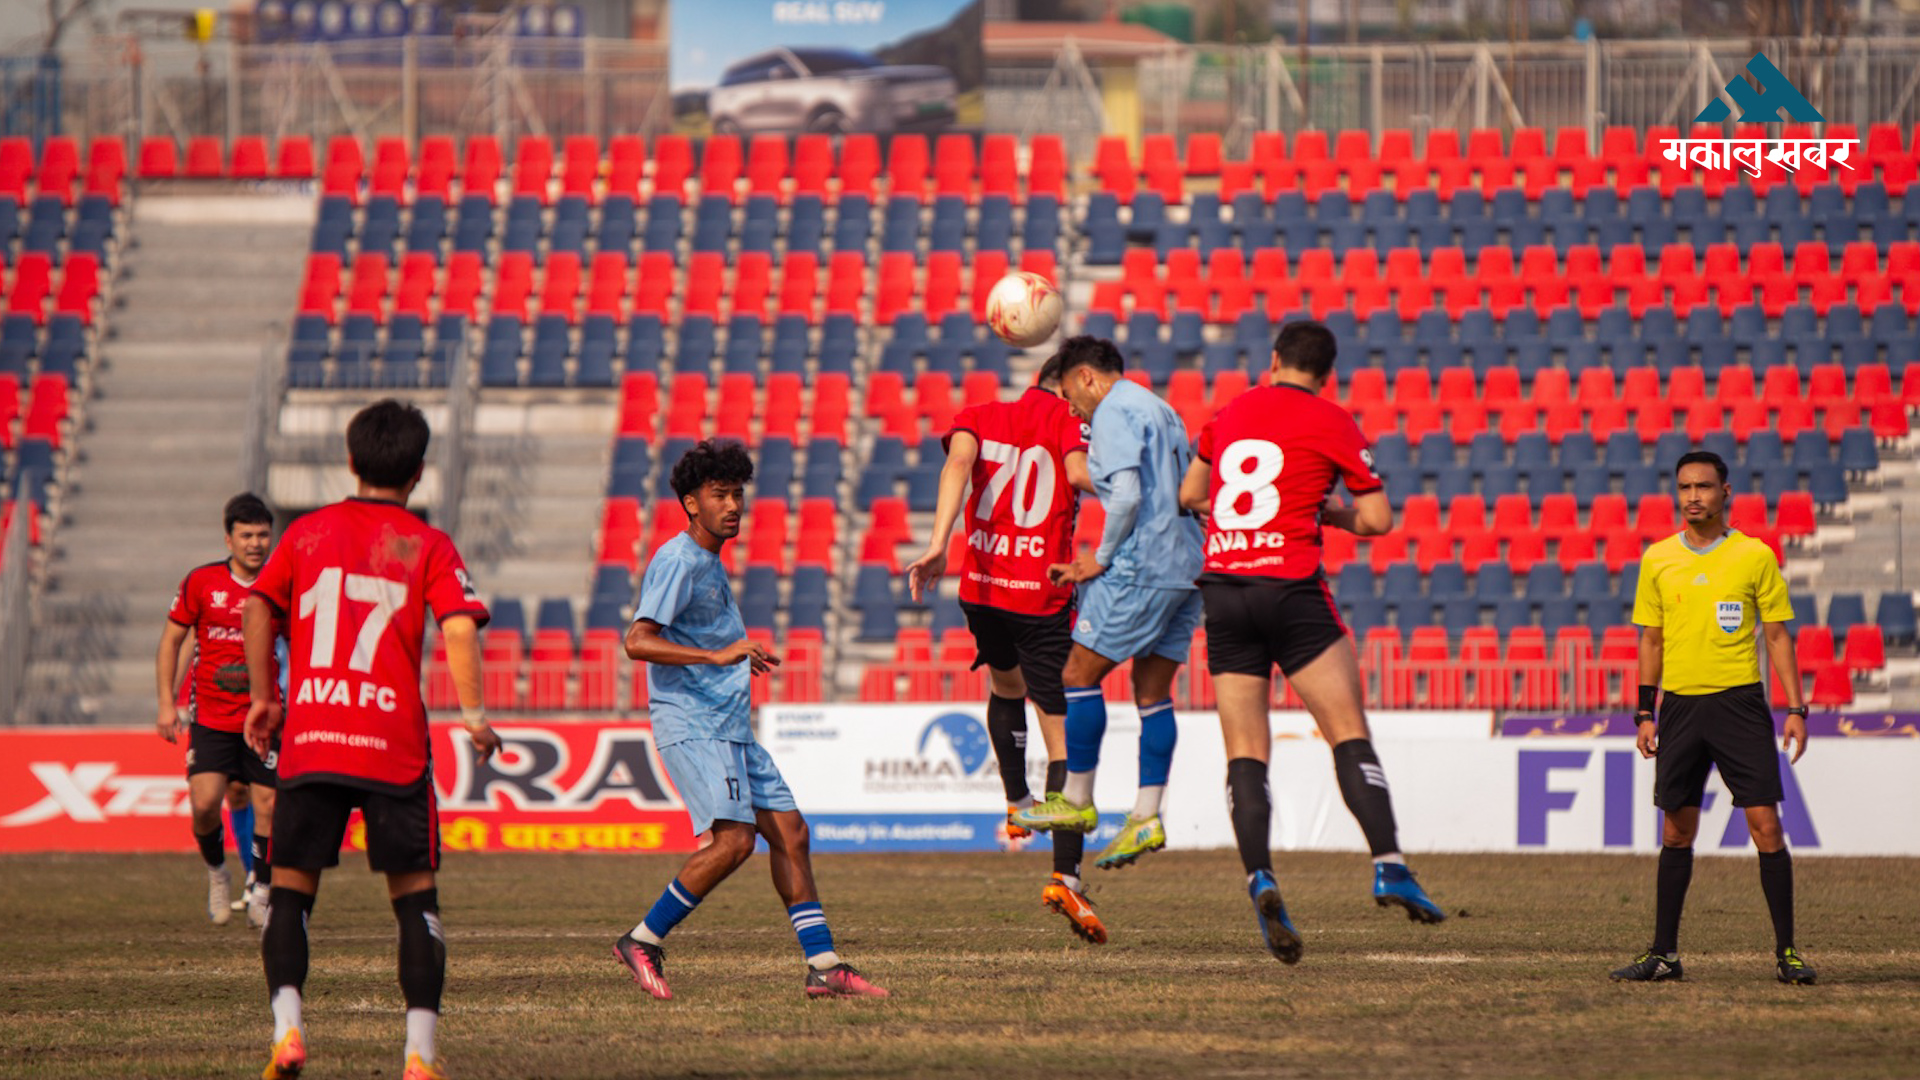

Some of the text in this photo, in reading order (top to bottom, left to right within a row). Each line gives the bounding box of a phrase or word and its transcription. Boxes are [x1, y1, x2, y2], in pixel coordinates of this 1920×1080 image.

[975, 439, 1056, 529] 70
[1213, 439, 1284, 531] 8
[968, 529, 1045, 558] AVA FC
[1208, 531, 1285, 557] AVA FC
[982, 574, 1008, 588] SPORTS
[1009, 579, 1041, 591] CENTER
[299, 566, 408, 674] 17
[1719, 603, 1741, 612] FIFA
[296, 678, 396, 712] AVA FC
[308, 729, 347, 746] SPORTS
[347, 733, 388, 751] CENTER
[436, 727, 689, 812] RA
[725, 776, 741, 801] 17
[1517, 750, 1821, 848] FIA
[815, 822, 975, 844] Study in Australia
